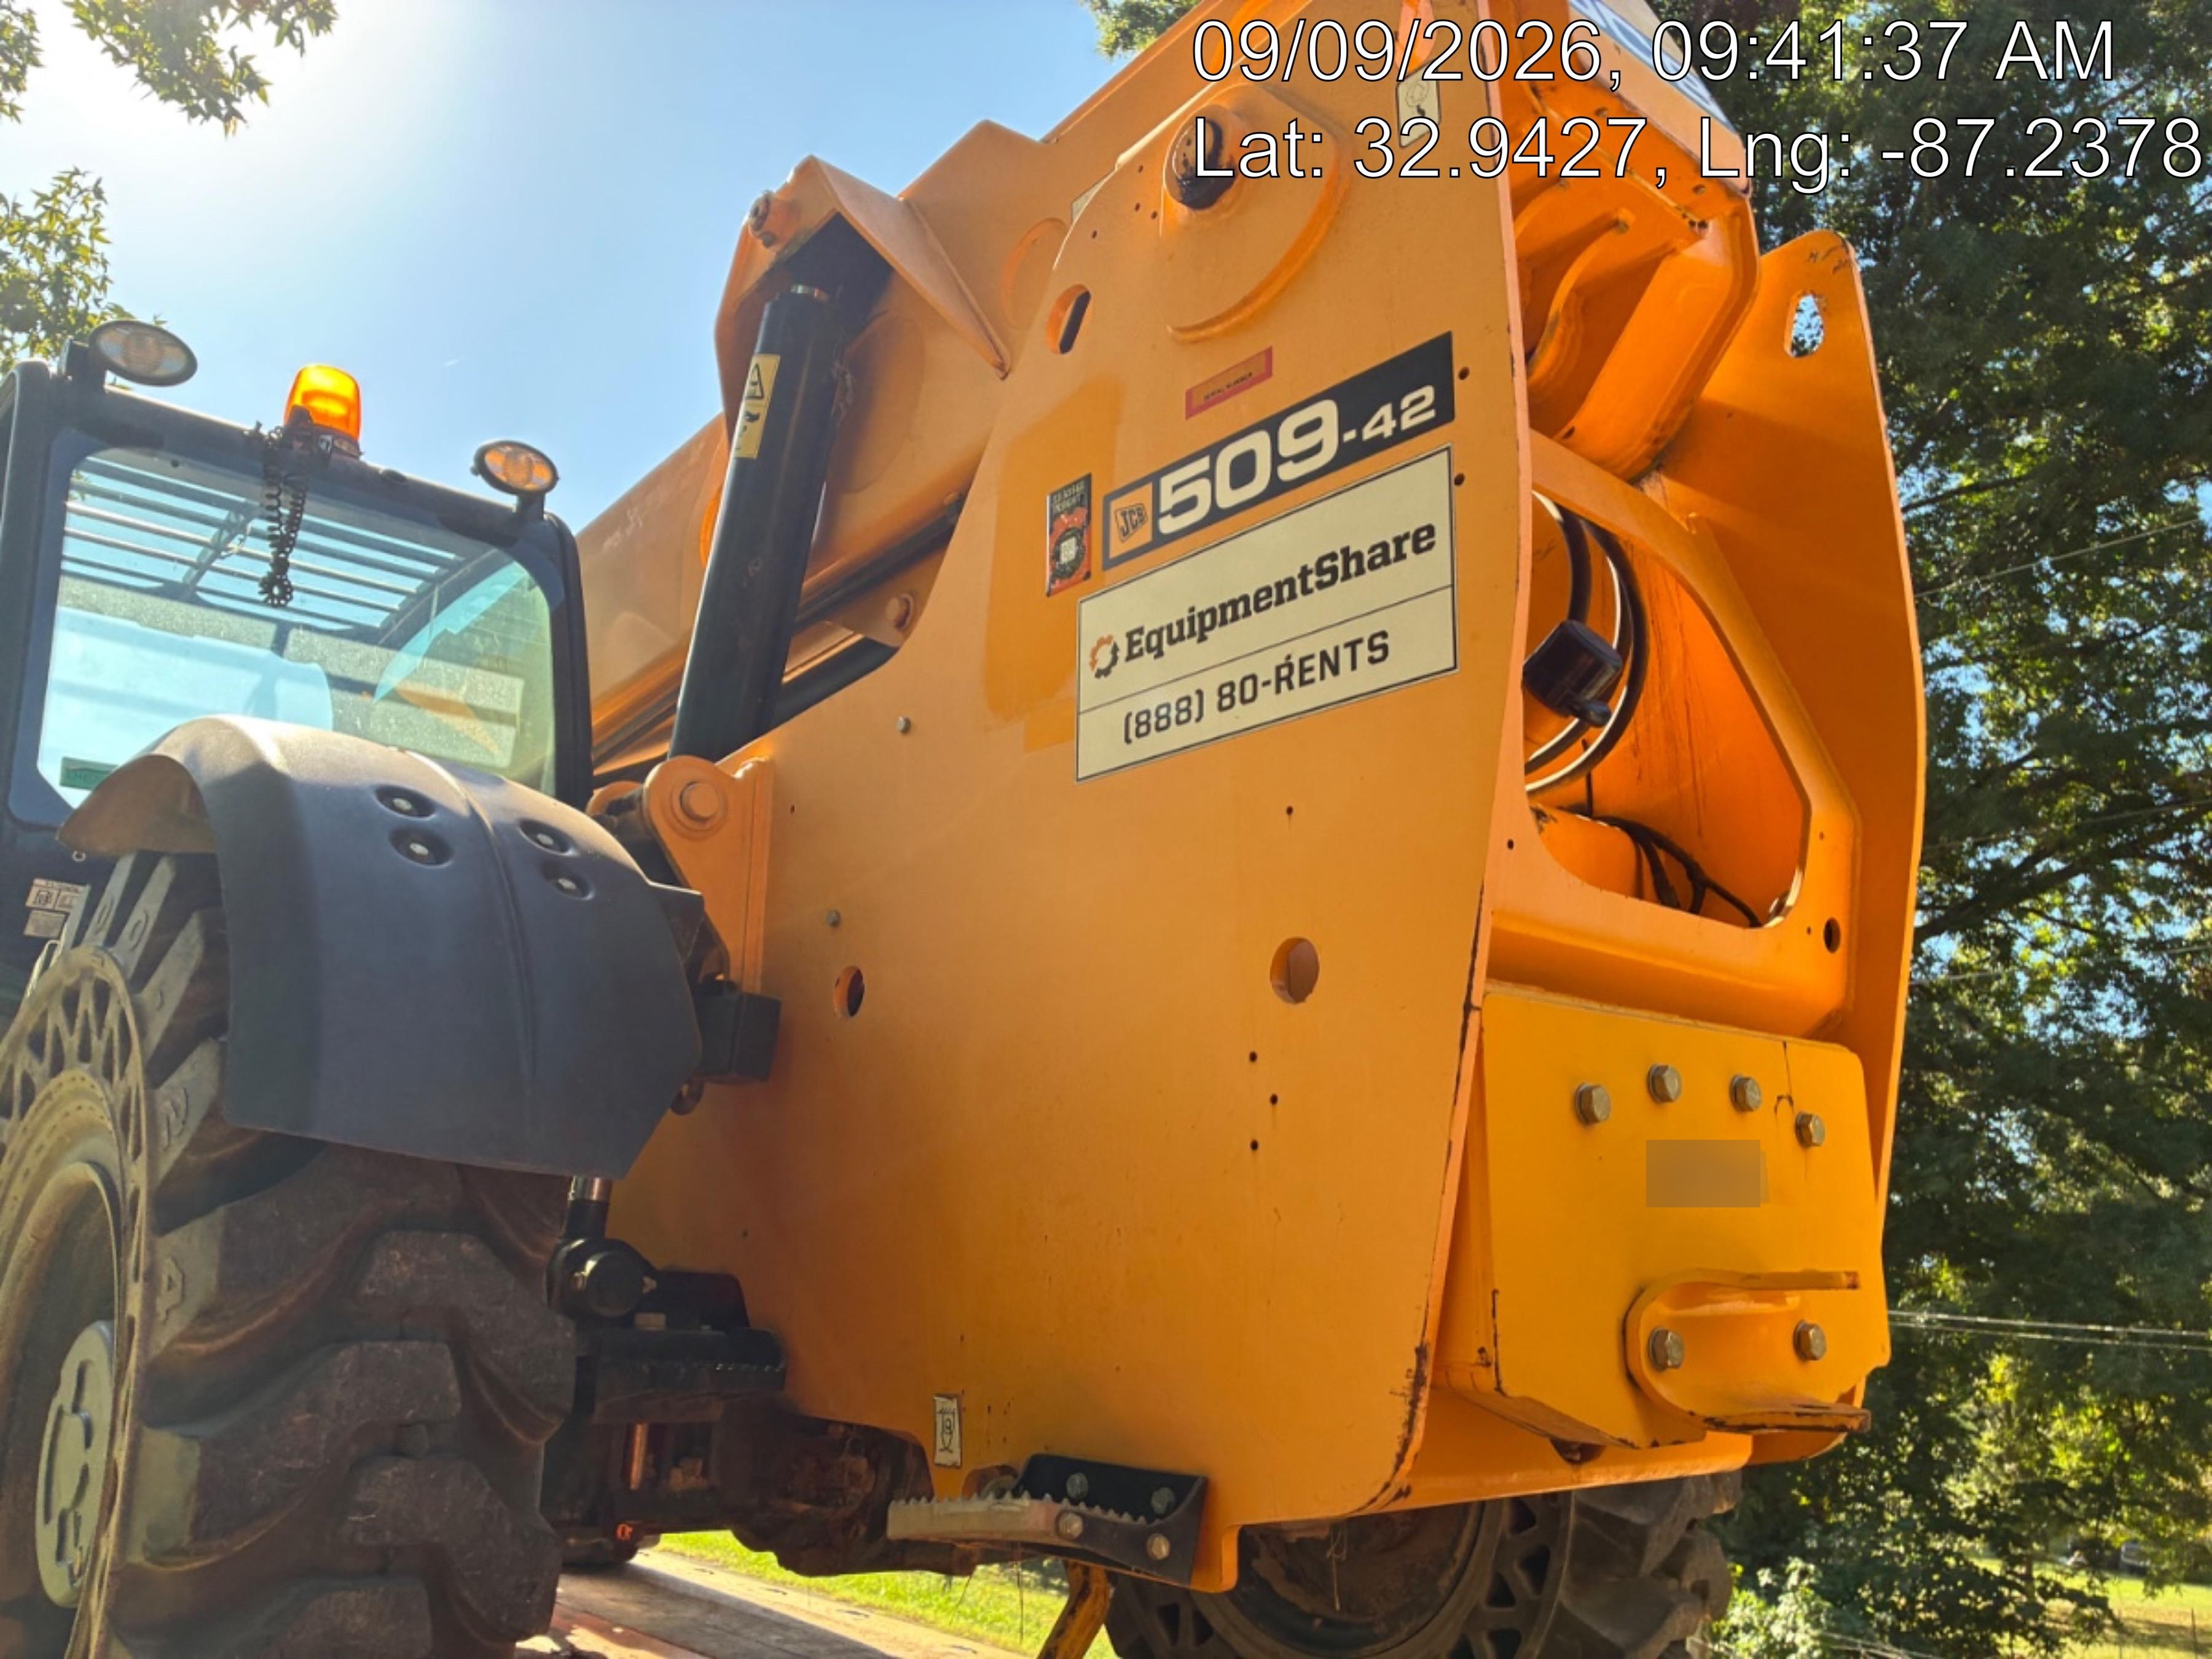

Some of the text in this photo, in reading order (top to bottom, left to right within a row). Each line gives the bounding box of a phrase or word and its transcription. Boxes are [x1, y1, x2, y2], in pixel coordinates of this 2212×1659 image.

[1117, 385, 1436, 539] JCB 509-42
[1124, 523, 1437, 662] EquipmentShare
[1124, 630, 1390, 745] (888) 80-RENTS
